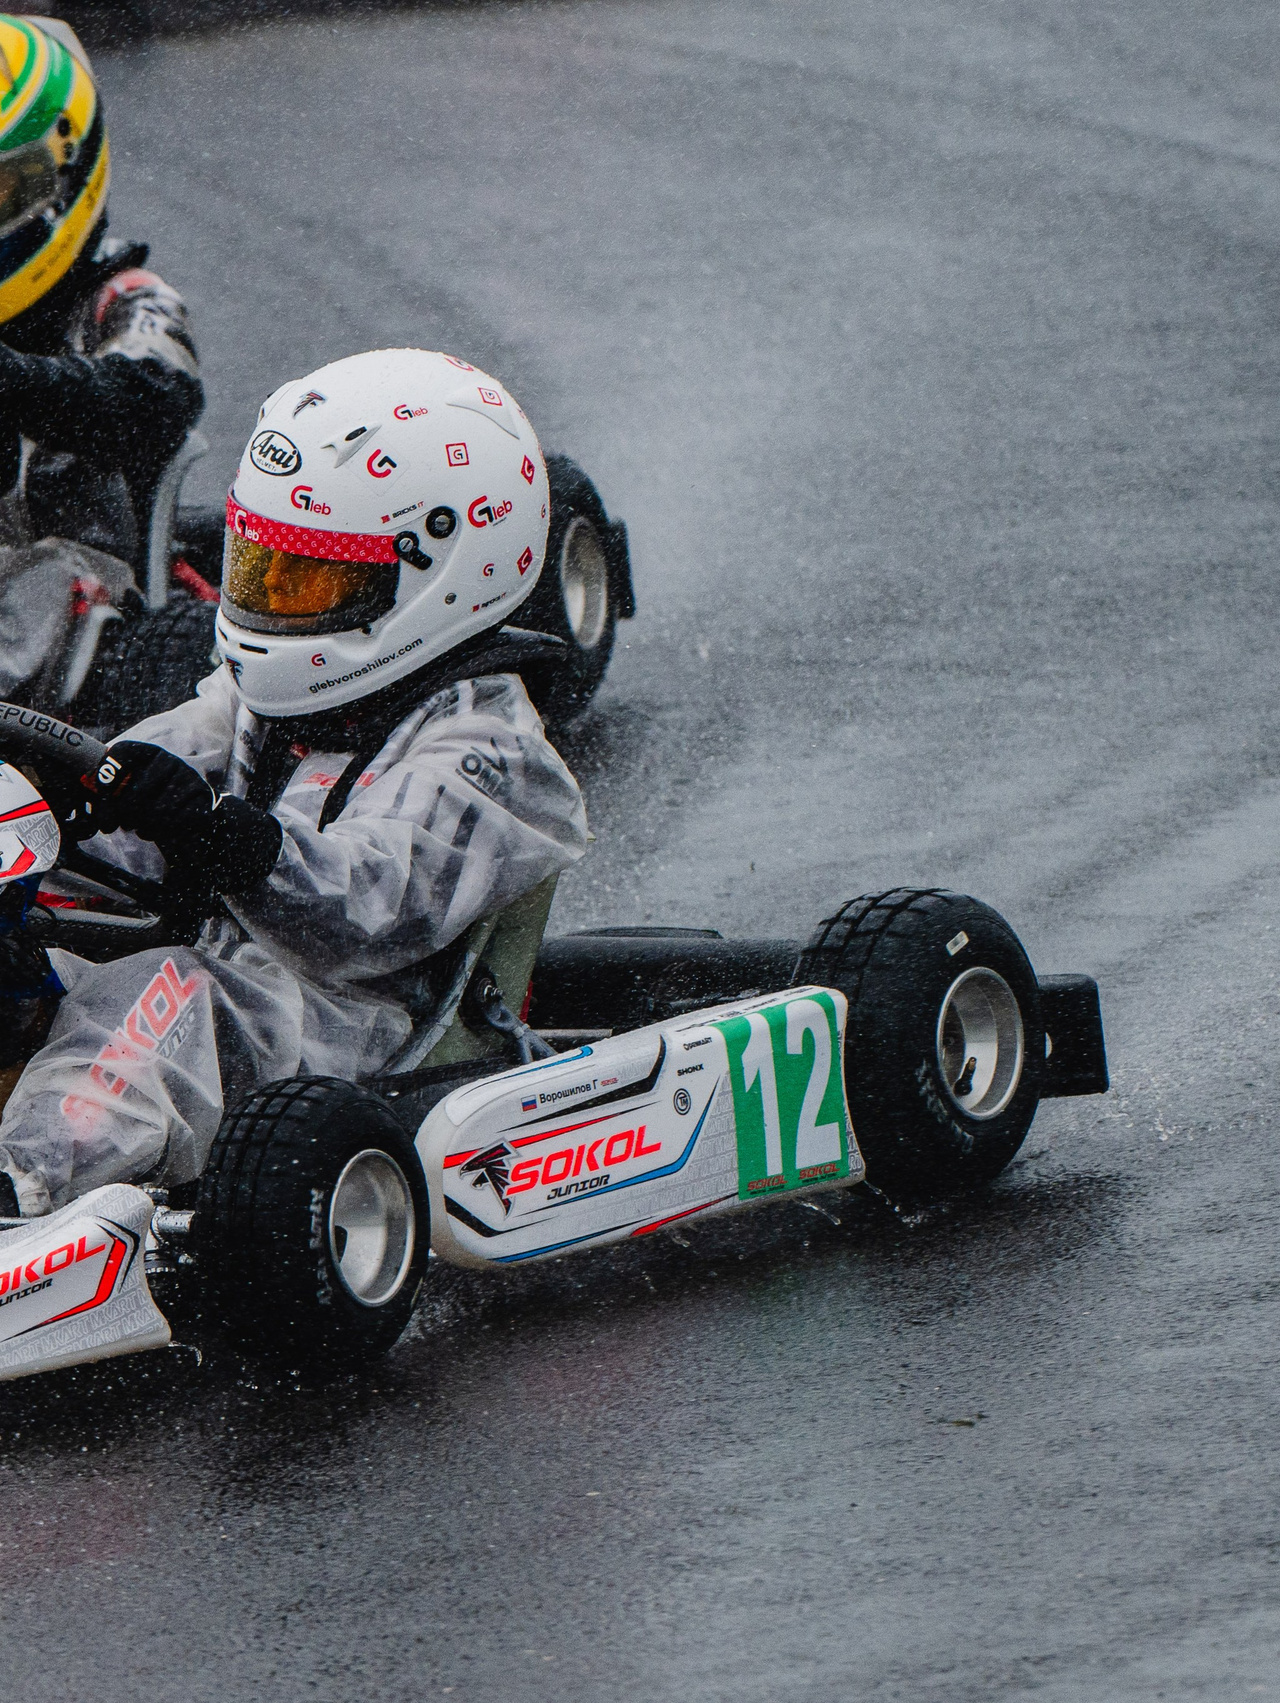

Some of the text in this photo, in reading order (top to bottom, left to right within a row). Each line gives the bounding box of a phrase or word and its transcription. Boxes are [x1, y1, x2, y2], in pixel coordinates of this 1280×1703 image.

[393, 403, 429, 421] Gleb
[251, 433, 299, 469] Arai
[290, 484, 332, 516] Gleb
[392, 504, 418, 519] BRICKS
[467, 495, 513, 528] Gleb
[308, 637, 424, 695] glebvoroshilov.com
[677, 1062, 705, 1077] SHONX
[538, 1078, 598, 1104] Ворошилов Г
[742, 998, 842, 1177] 12
[506, 1124, 662, 1198] SOKOL
[799, 1163, 840, 1180] SOKOL
[546, 1173, 611, 1201] JUNIOR
[746, 1175, 788, 1192] SOKOL
